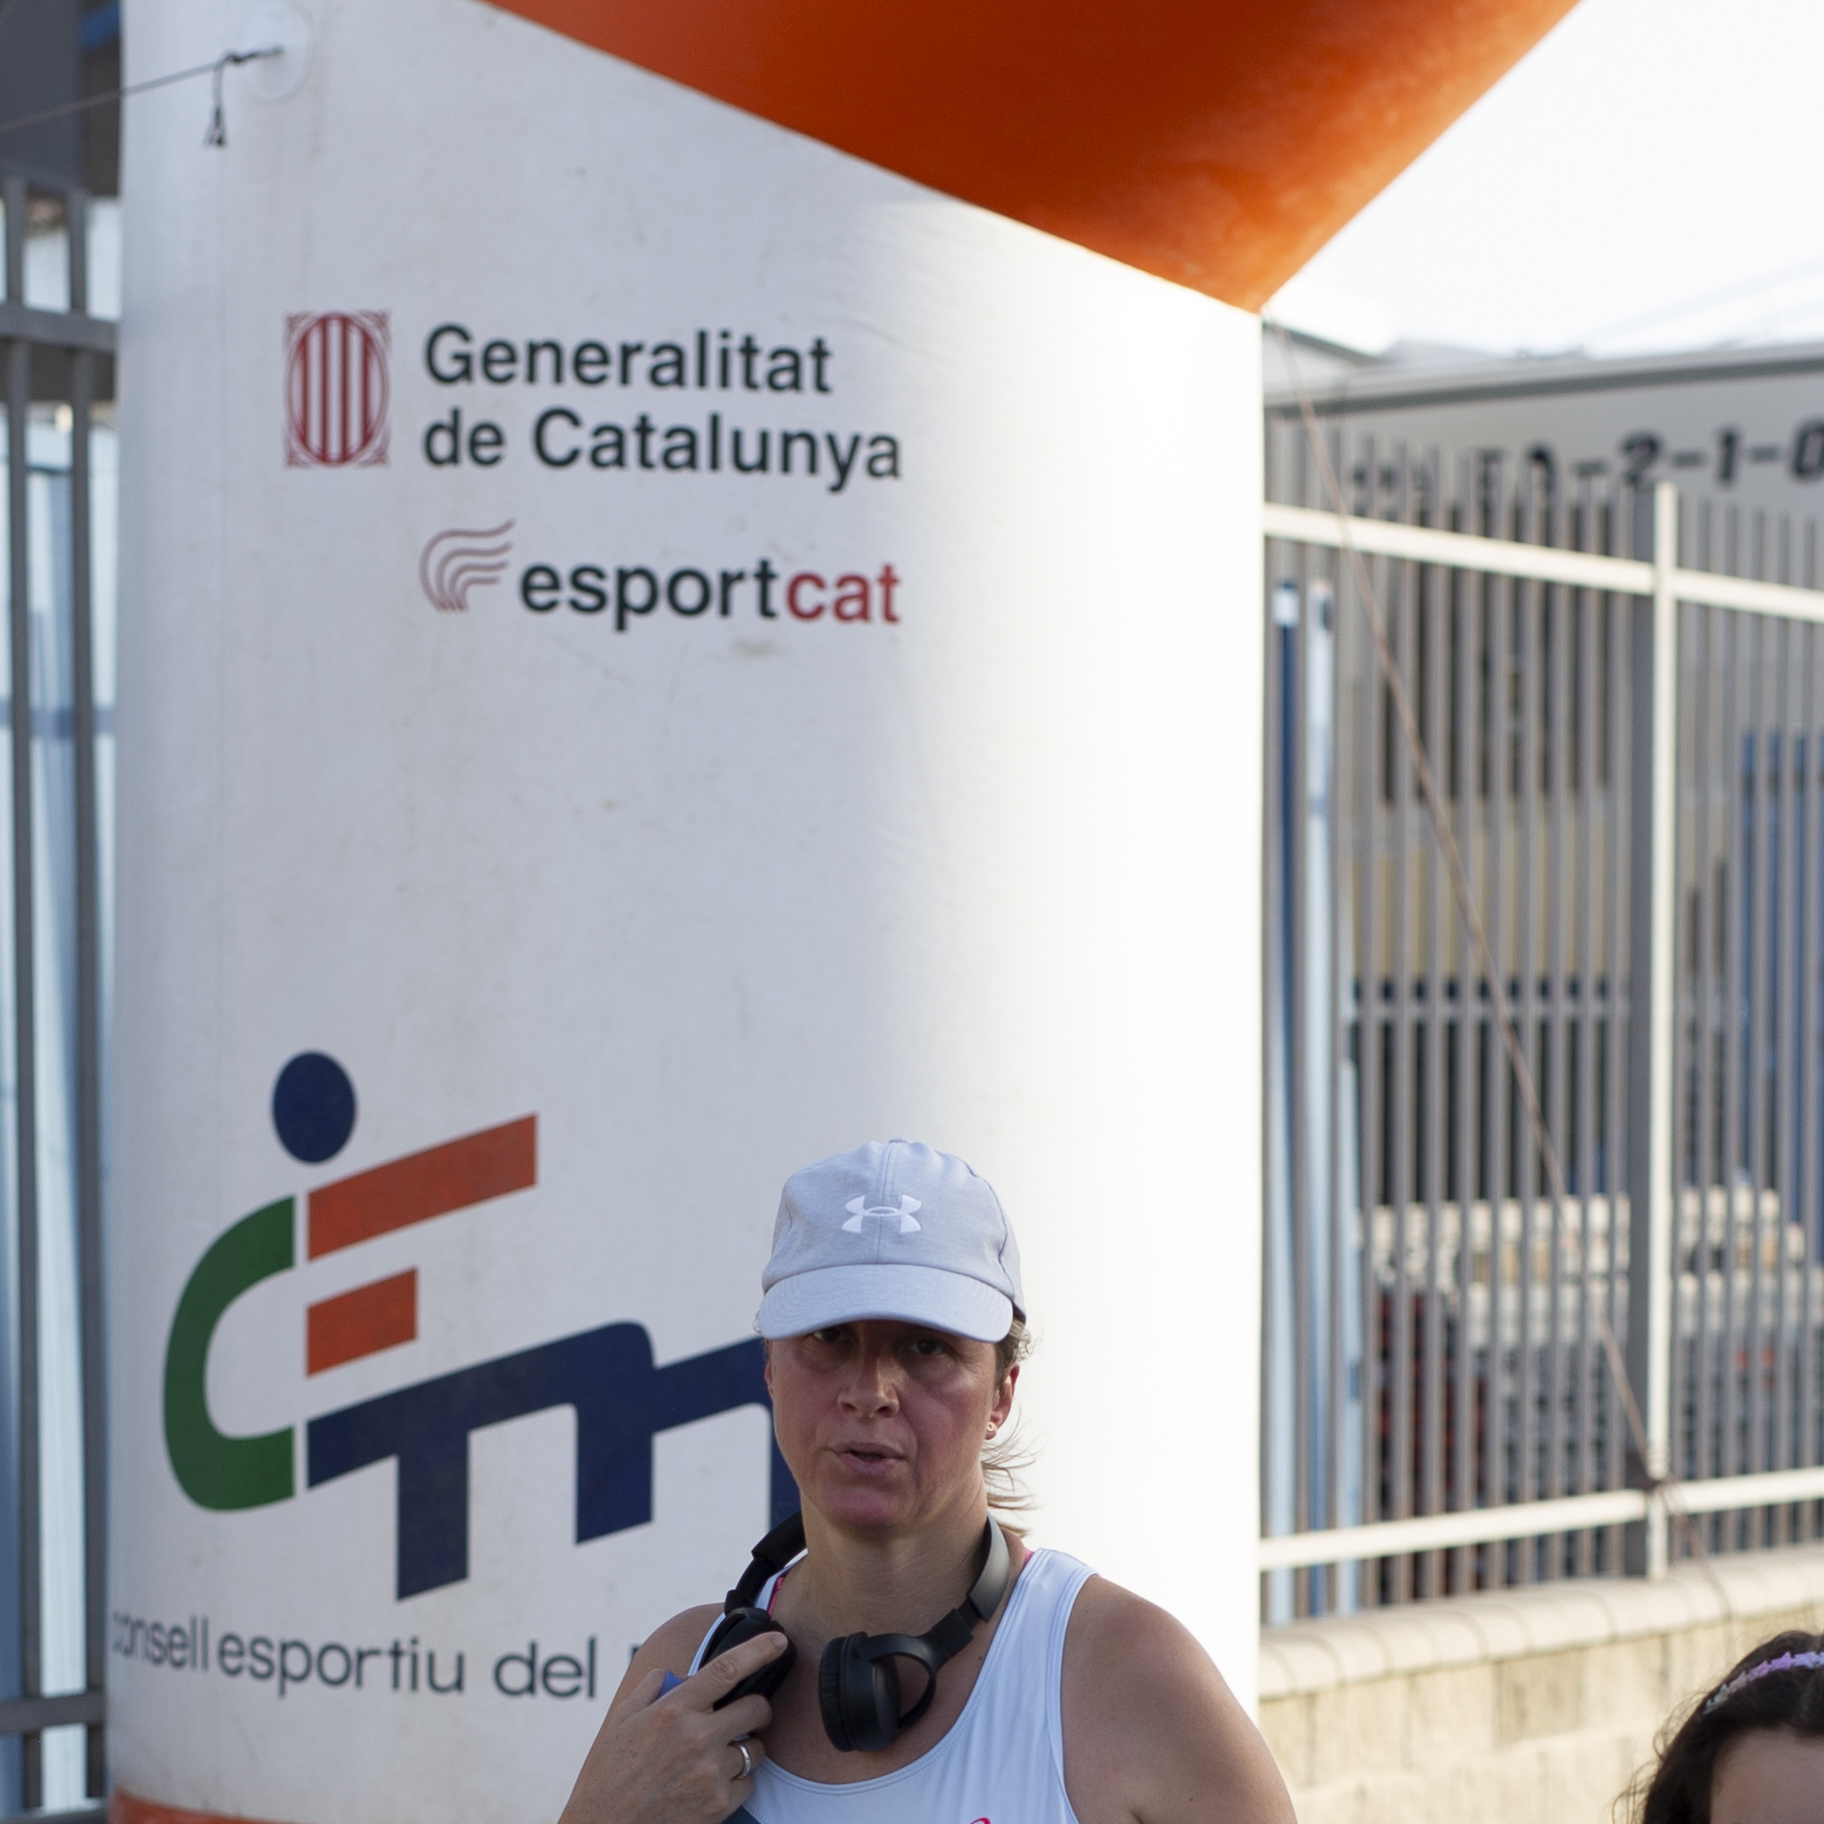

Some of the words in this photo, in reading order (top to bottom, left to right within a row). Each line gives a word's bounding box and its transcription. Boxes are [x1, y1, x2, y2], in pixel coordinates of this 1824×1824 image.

[424, 322, 833, 395] Generalitat
[423, 407, 506, 468] de
[532, 407, 902, 494] Catalunya
[519, 557, 902, 632] esportcat
[218, 1636, 465, 1698] esportiu
[493, 1636, 597, 1700] del
